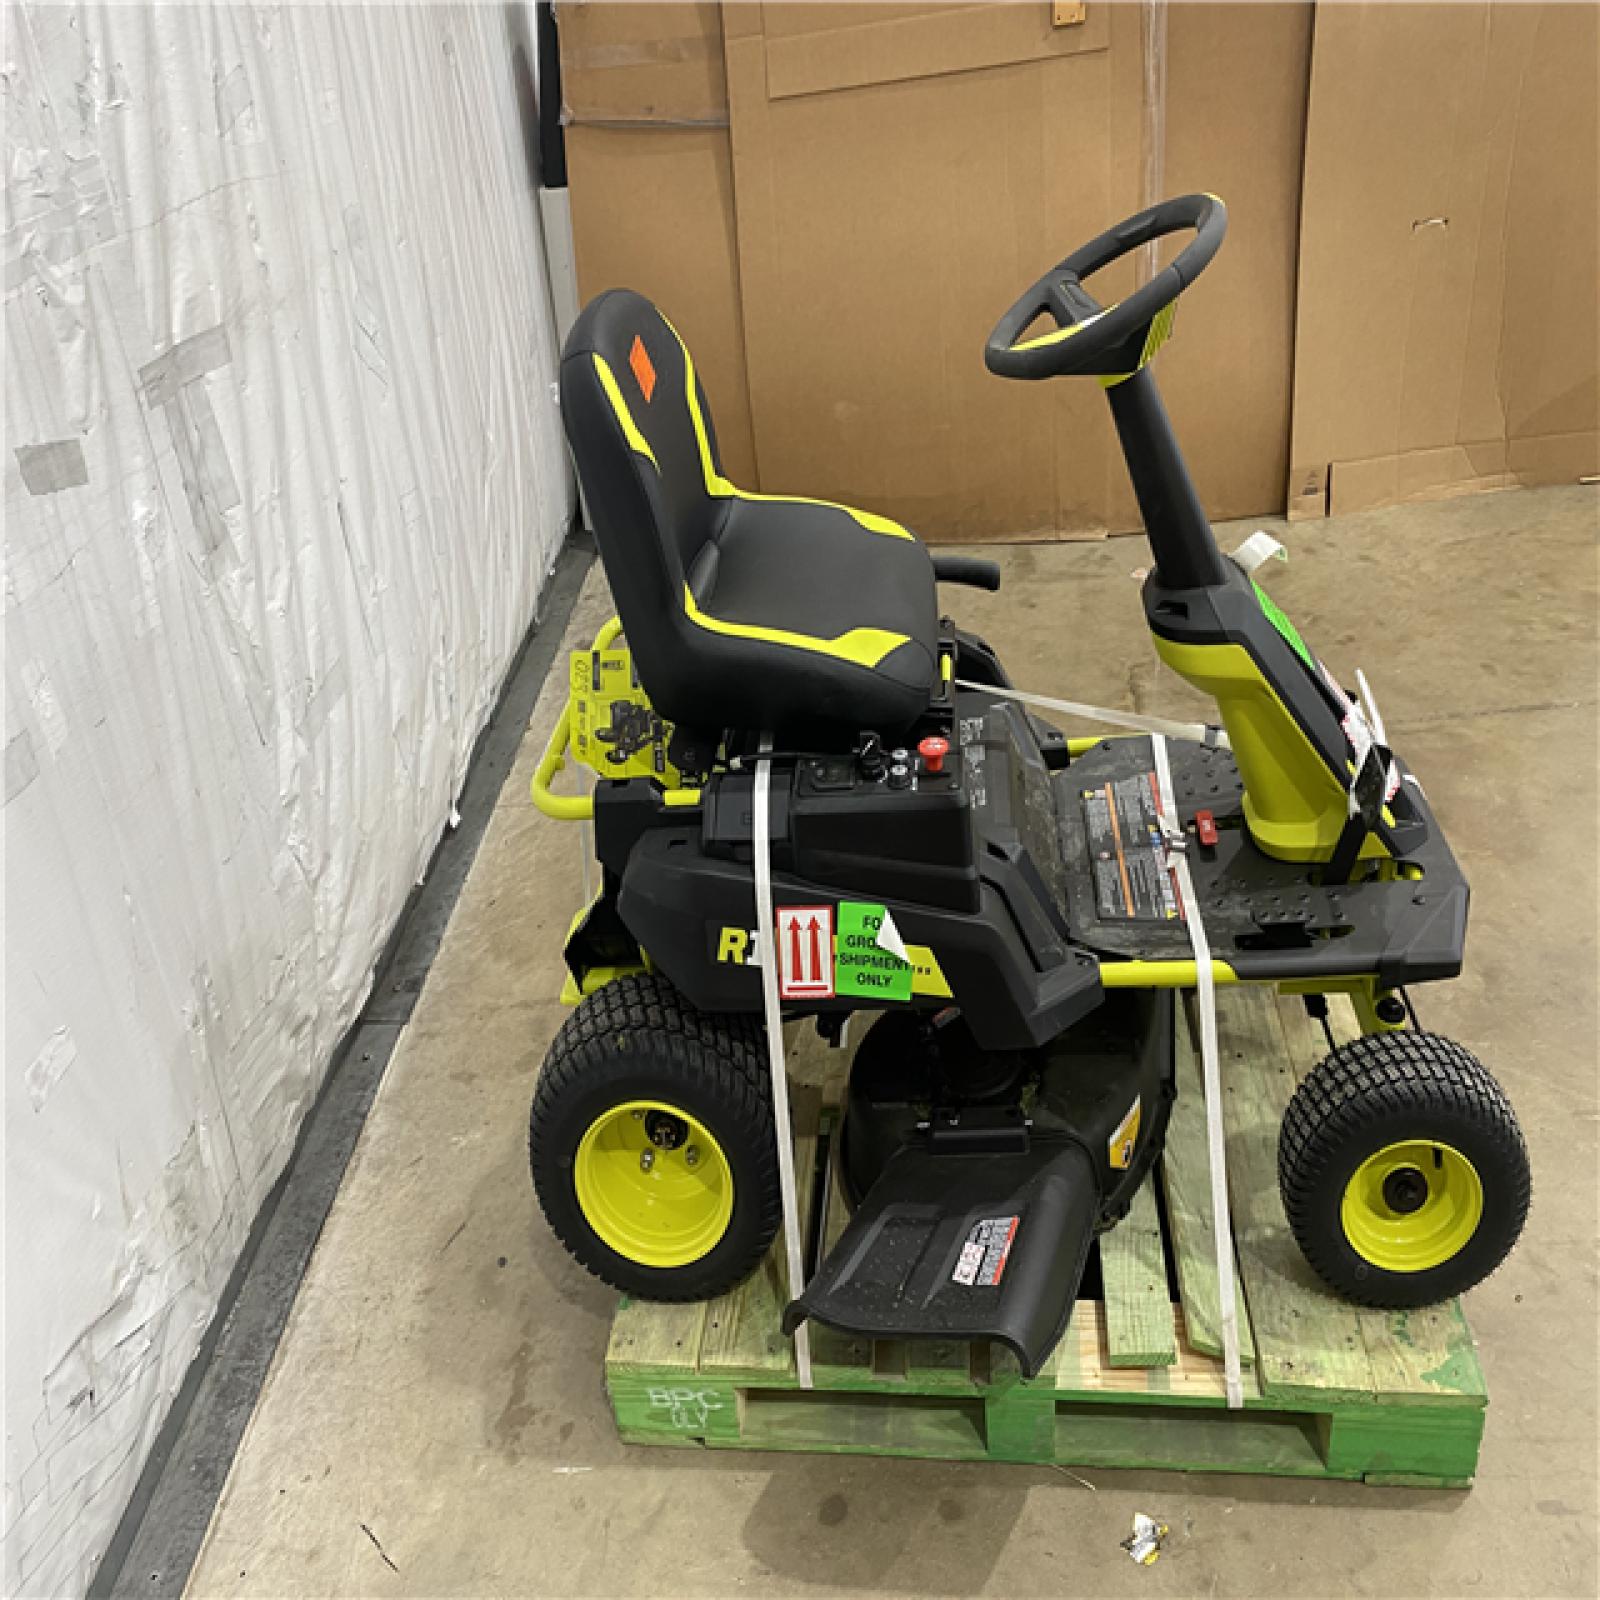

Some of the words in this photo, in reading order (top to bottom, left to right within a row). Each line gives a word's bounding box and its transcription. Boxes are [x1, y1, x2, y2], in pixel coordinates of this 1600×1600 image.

[863, 914, 881, 931] FO
[856, 971, 893, 988] ONLY
[648, 1386, 723, 1410] BPC
